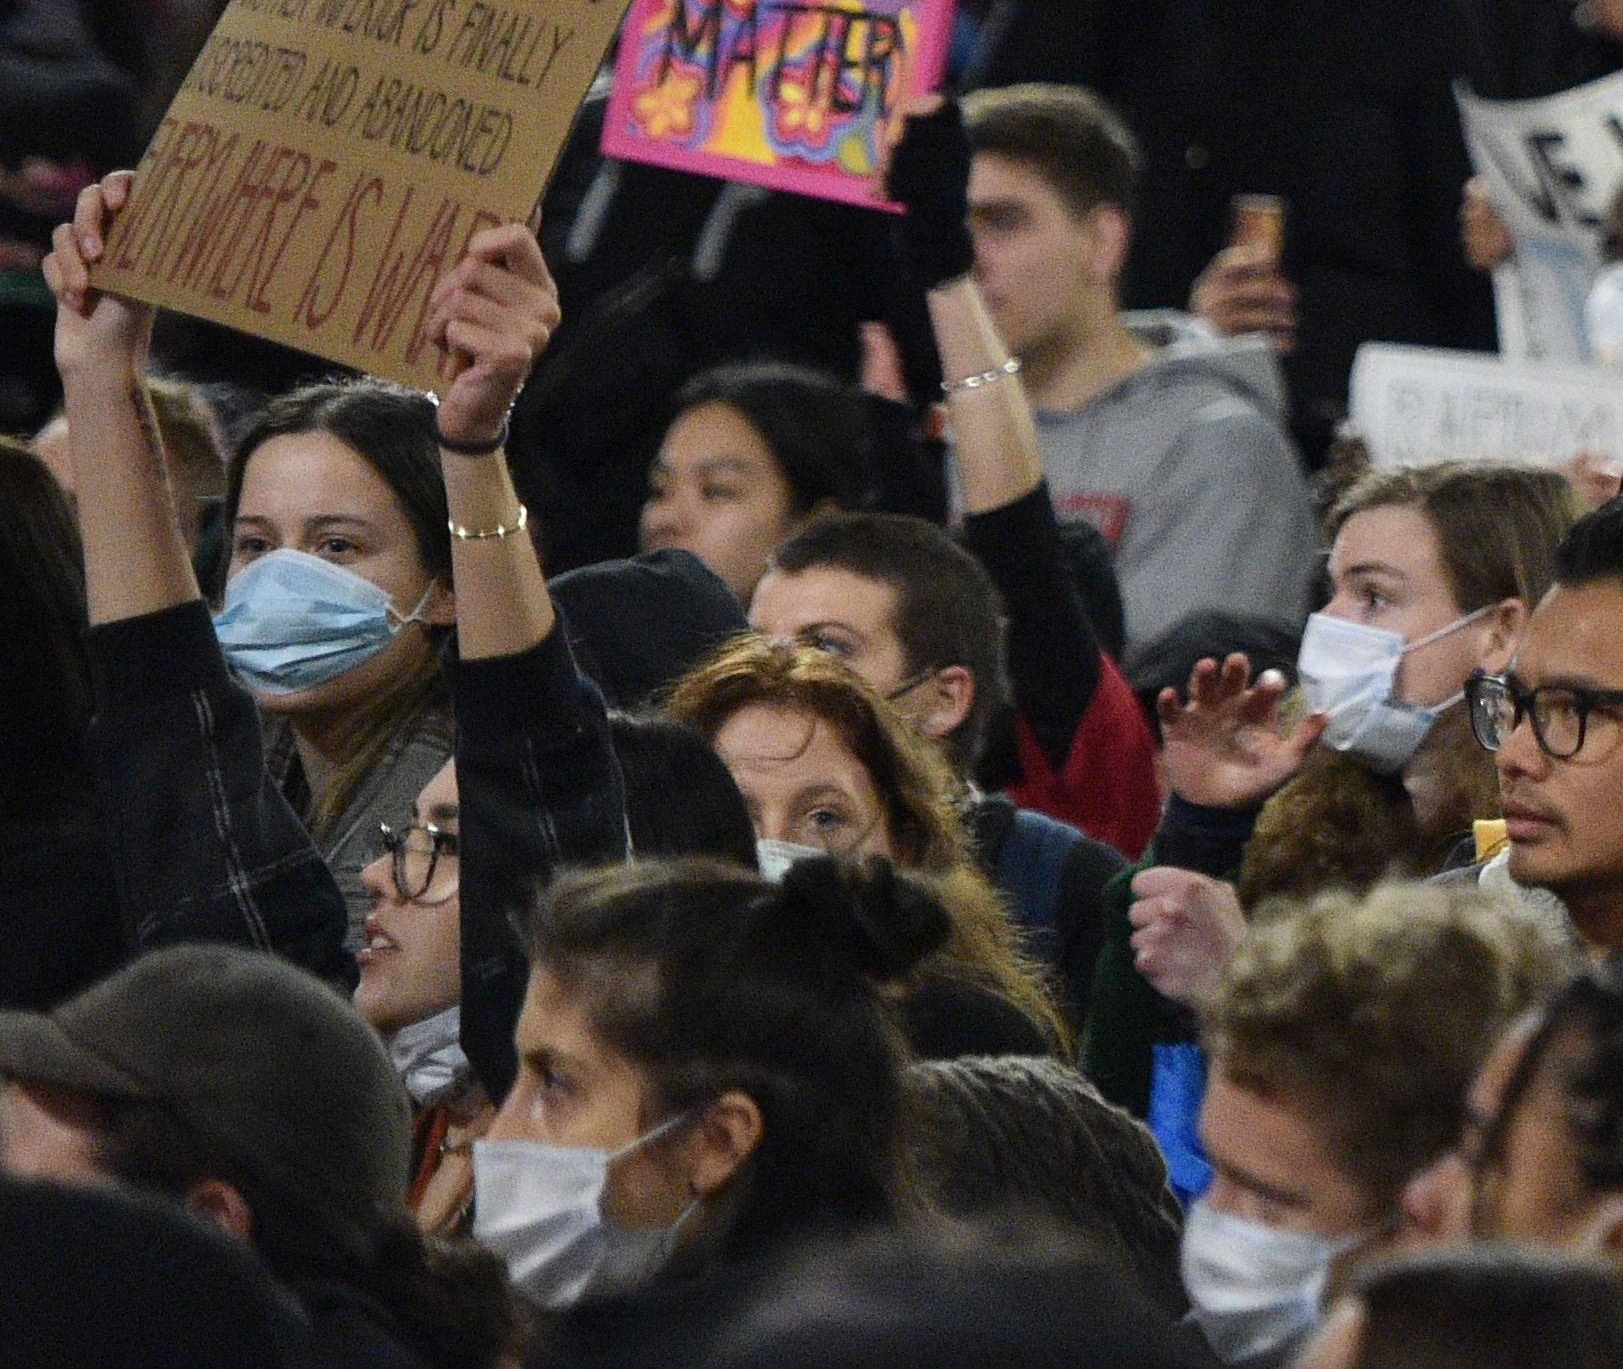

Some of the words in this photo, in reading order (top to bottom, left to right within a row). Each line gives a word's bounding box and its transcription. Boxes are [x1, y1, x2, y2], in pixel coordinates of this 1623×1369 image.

[445, 0, 576, 90] FINALLY
[298, 58, 360, 129] AND
[350, 76, 514, 178] ABANDONED
[294, 166, 384, 333] IS
